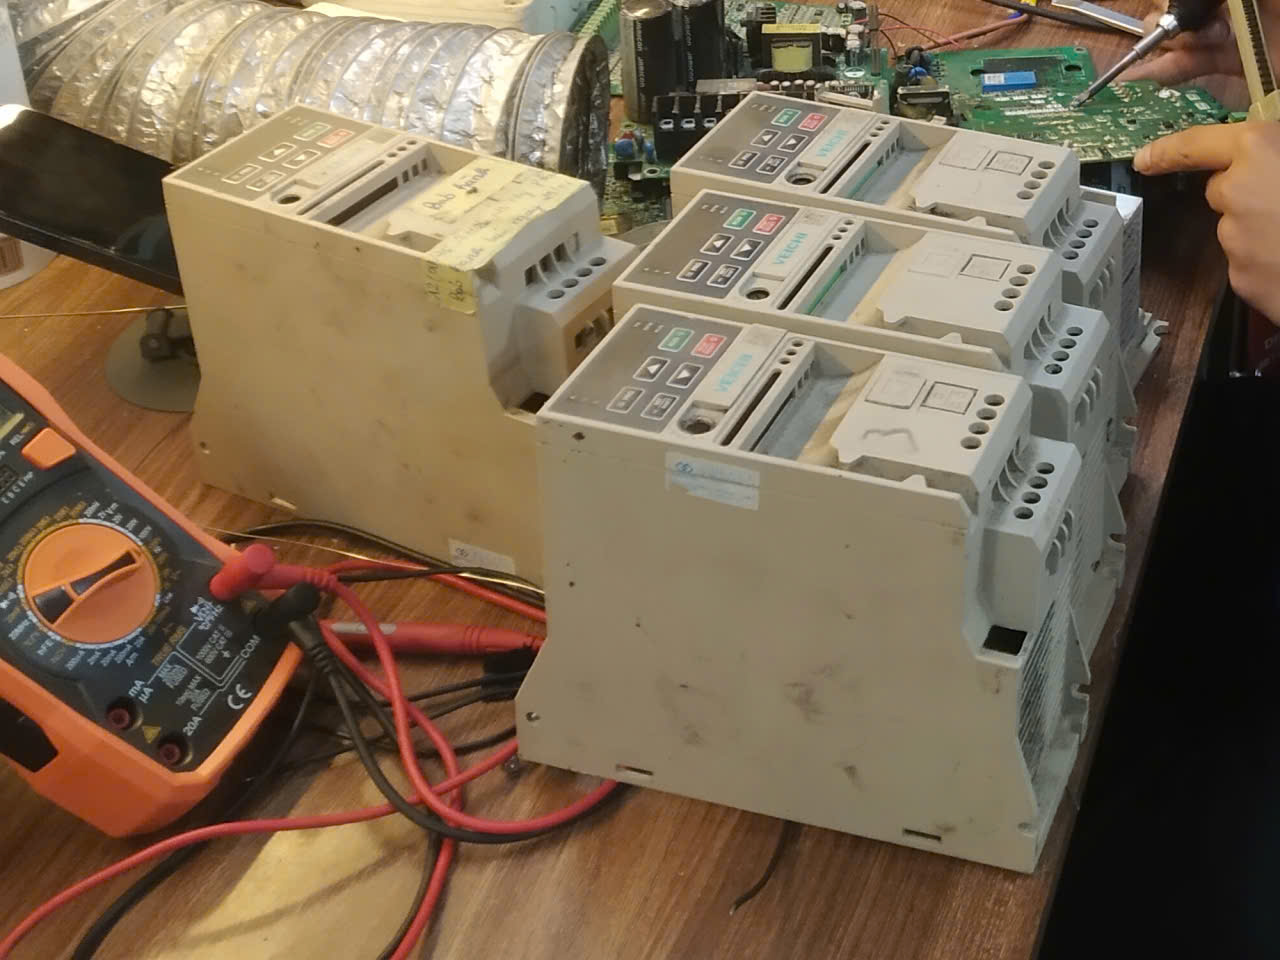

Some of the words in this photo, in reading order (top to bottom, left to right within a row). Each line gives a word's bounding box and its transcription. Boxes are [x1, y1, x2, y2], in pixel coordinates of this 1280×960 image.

[240, 635, 261, 659] COM
[128, 680, 145, 697] mA
[183, 716, 202, 736] 20A
